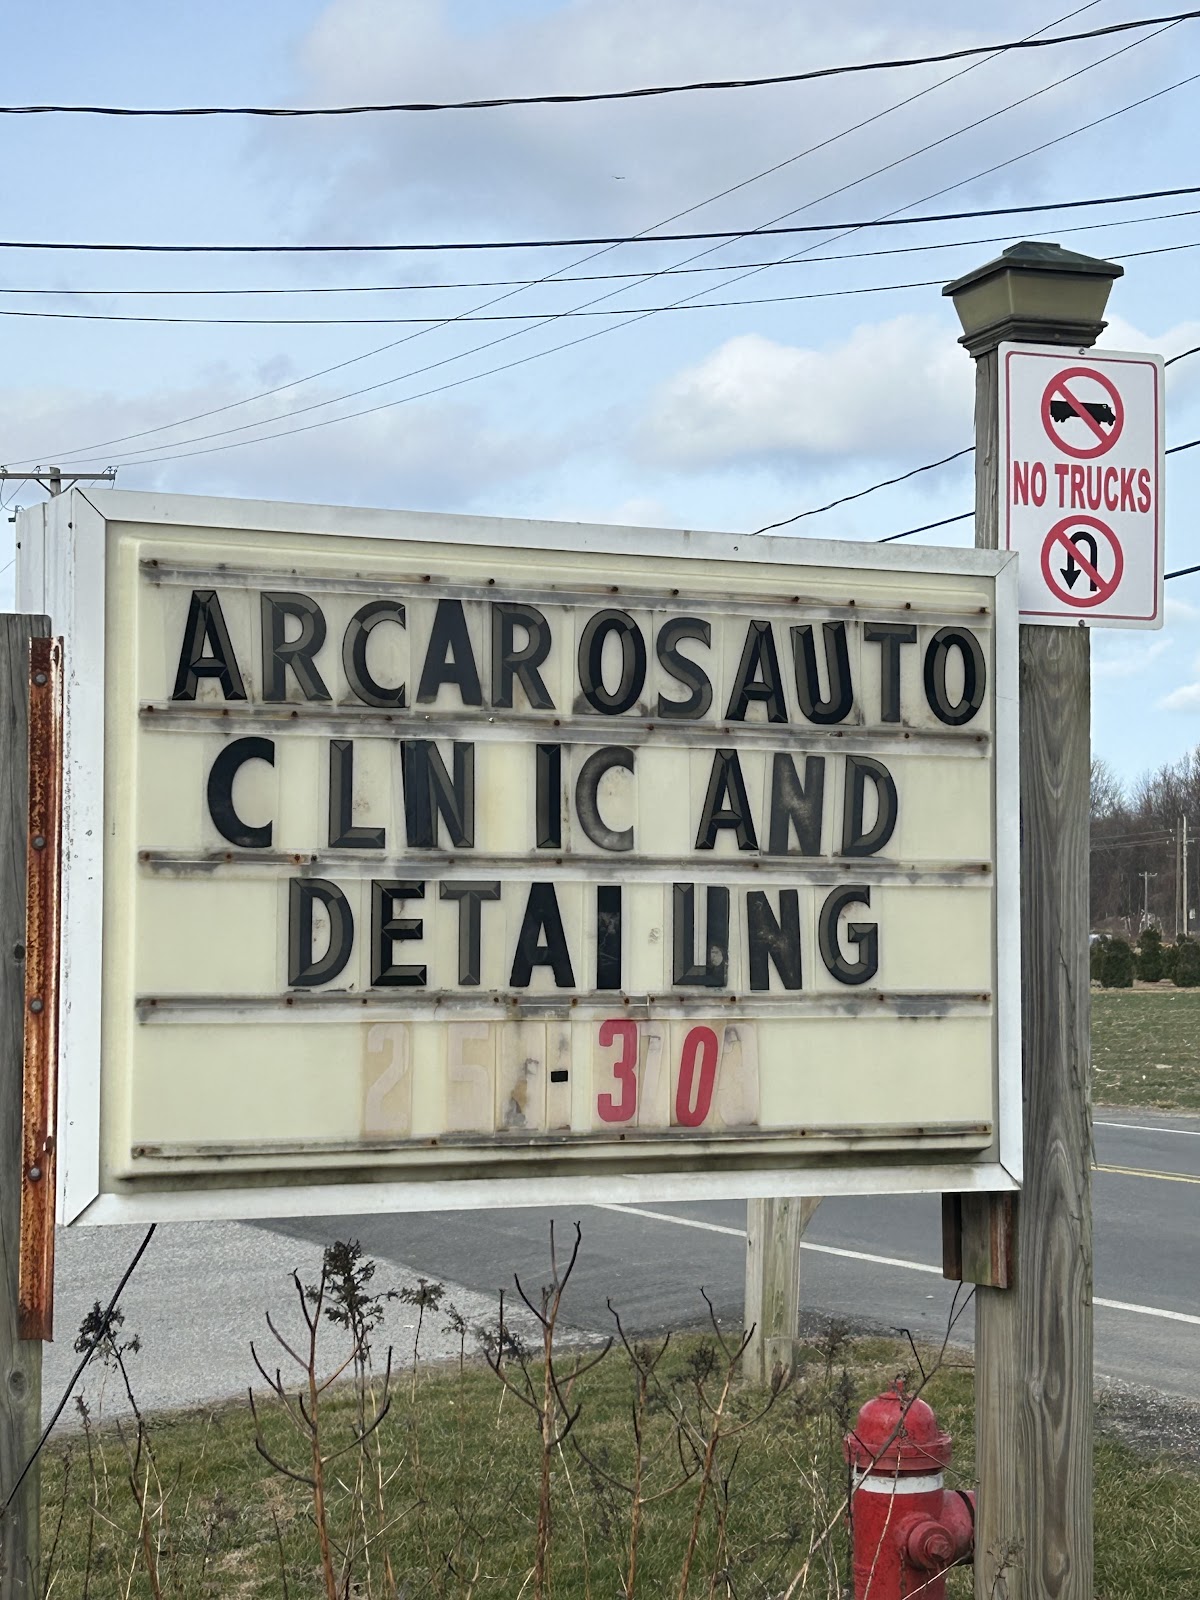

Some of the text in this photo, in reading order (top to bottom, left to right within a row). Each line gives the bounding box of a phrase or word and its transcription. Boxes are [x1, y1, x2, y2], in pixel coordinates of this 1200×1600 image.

[1013, 460, 1152, 514] NO TRUCKS
[694, 748, 899, 856] AND
